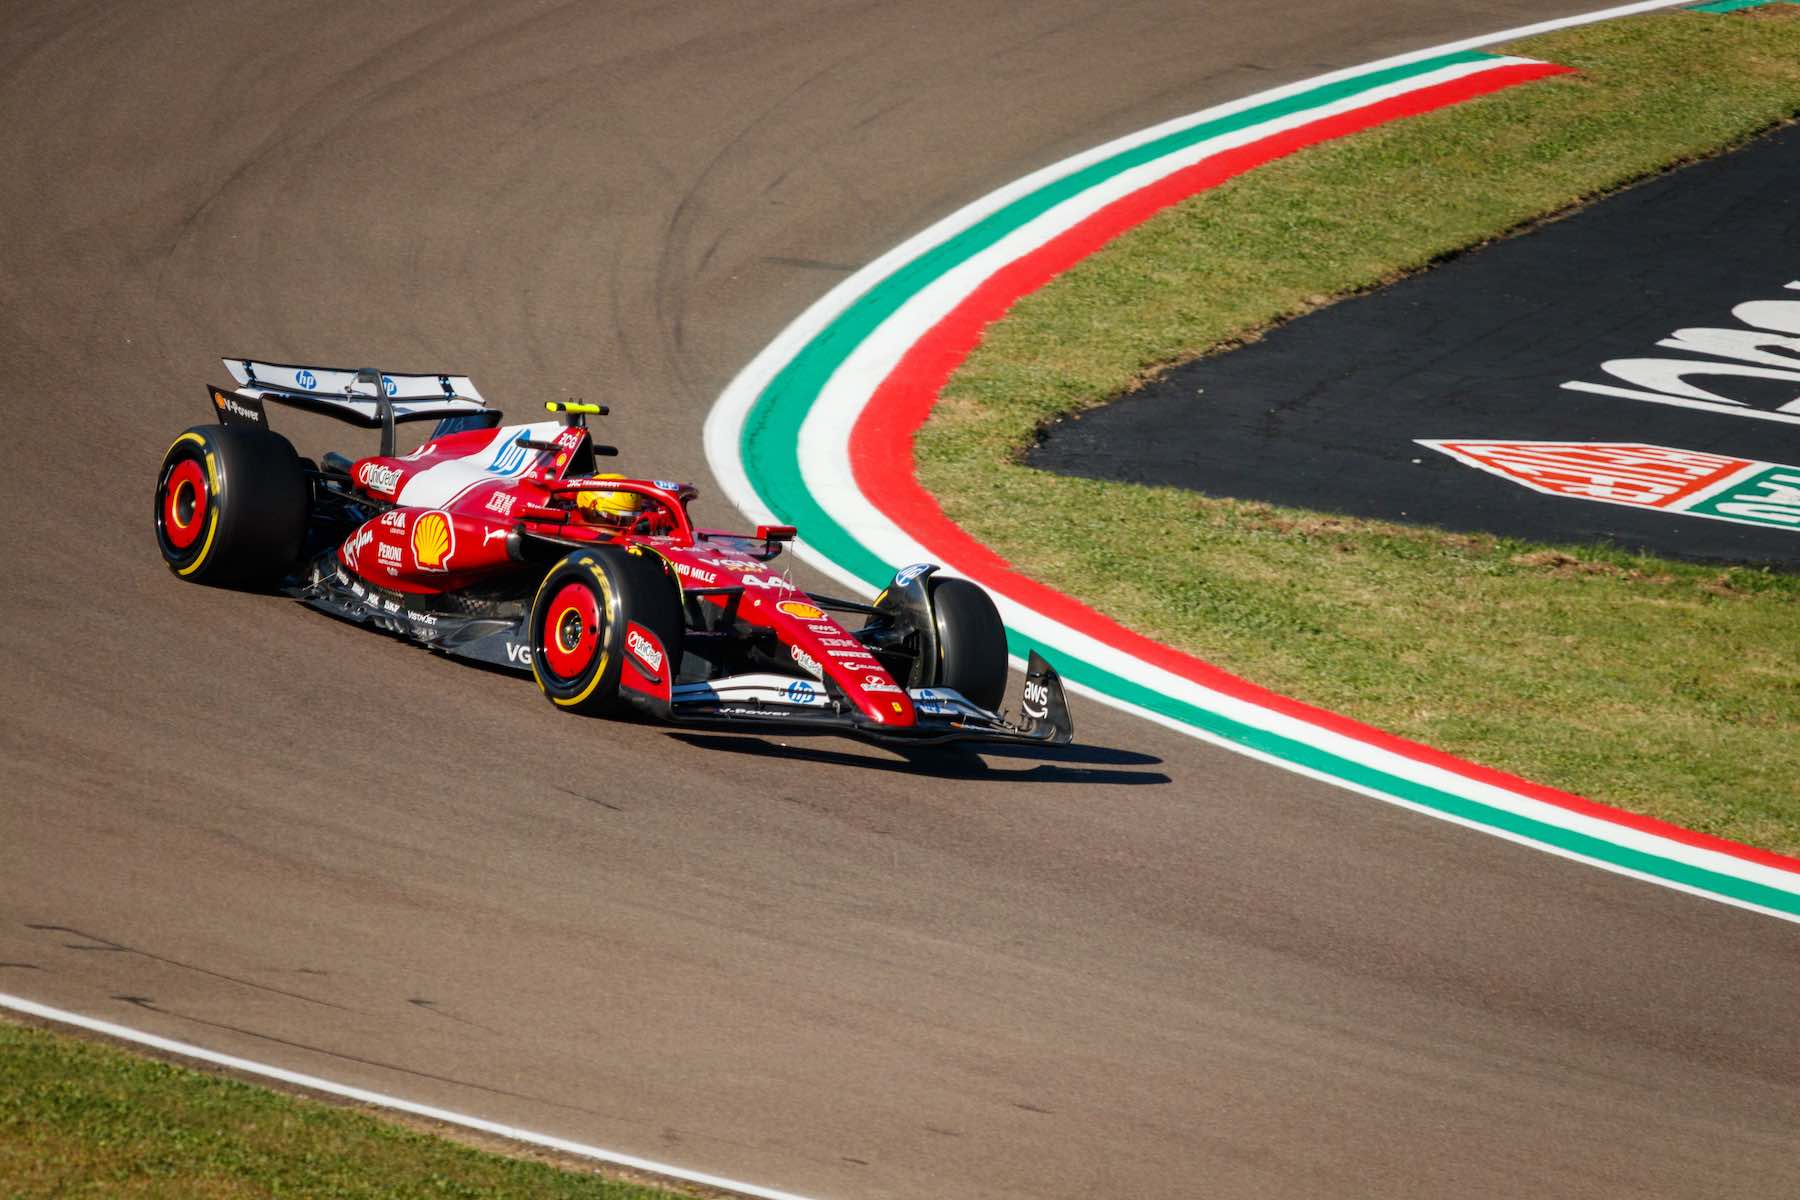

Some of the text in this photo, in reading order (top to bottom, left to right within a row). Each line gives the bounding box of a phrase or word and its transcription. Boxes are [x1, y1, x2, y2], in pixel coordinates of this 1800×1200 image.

[224, 398, 259, 421] V-Power
[485, 491, 517, 515] IBM
[377, 541, 402, 562] PERONI
[690, 567, 717, 583] MILLE
[506, 642, 532, 664] VG
[1024, 681, 1048, 705] aws
[719, 708, 790, 716] V-Power
